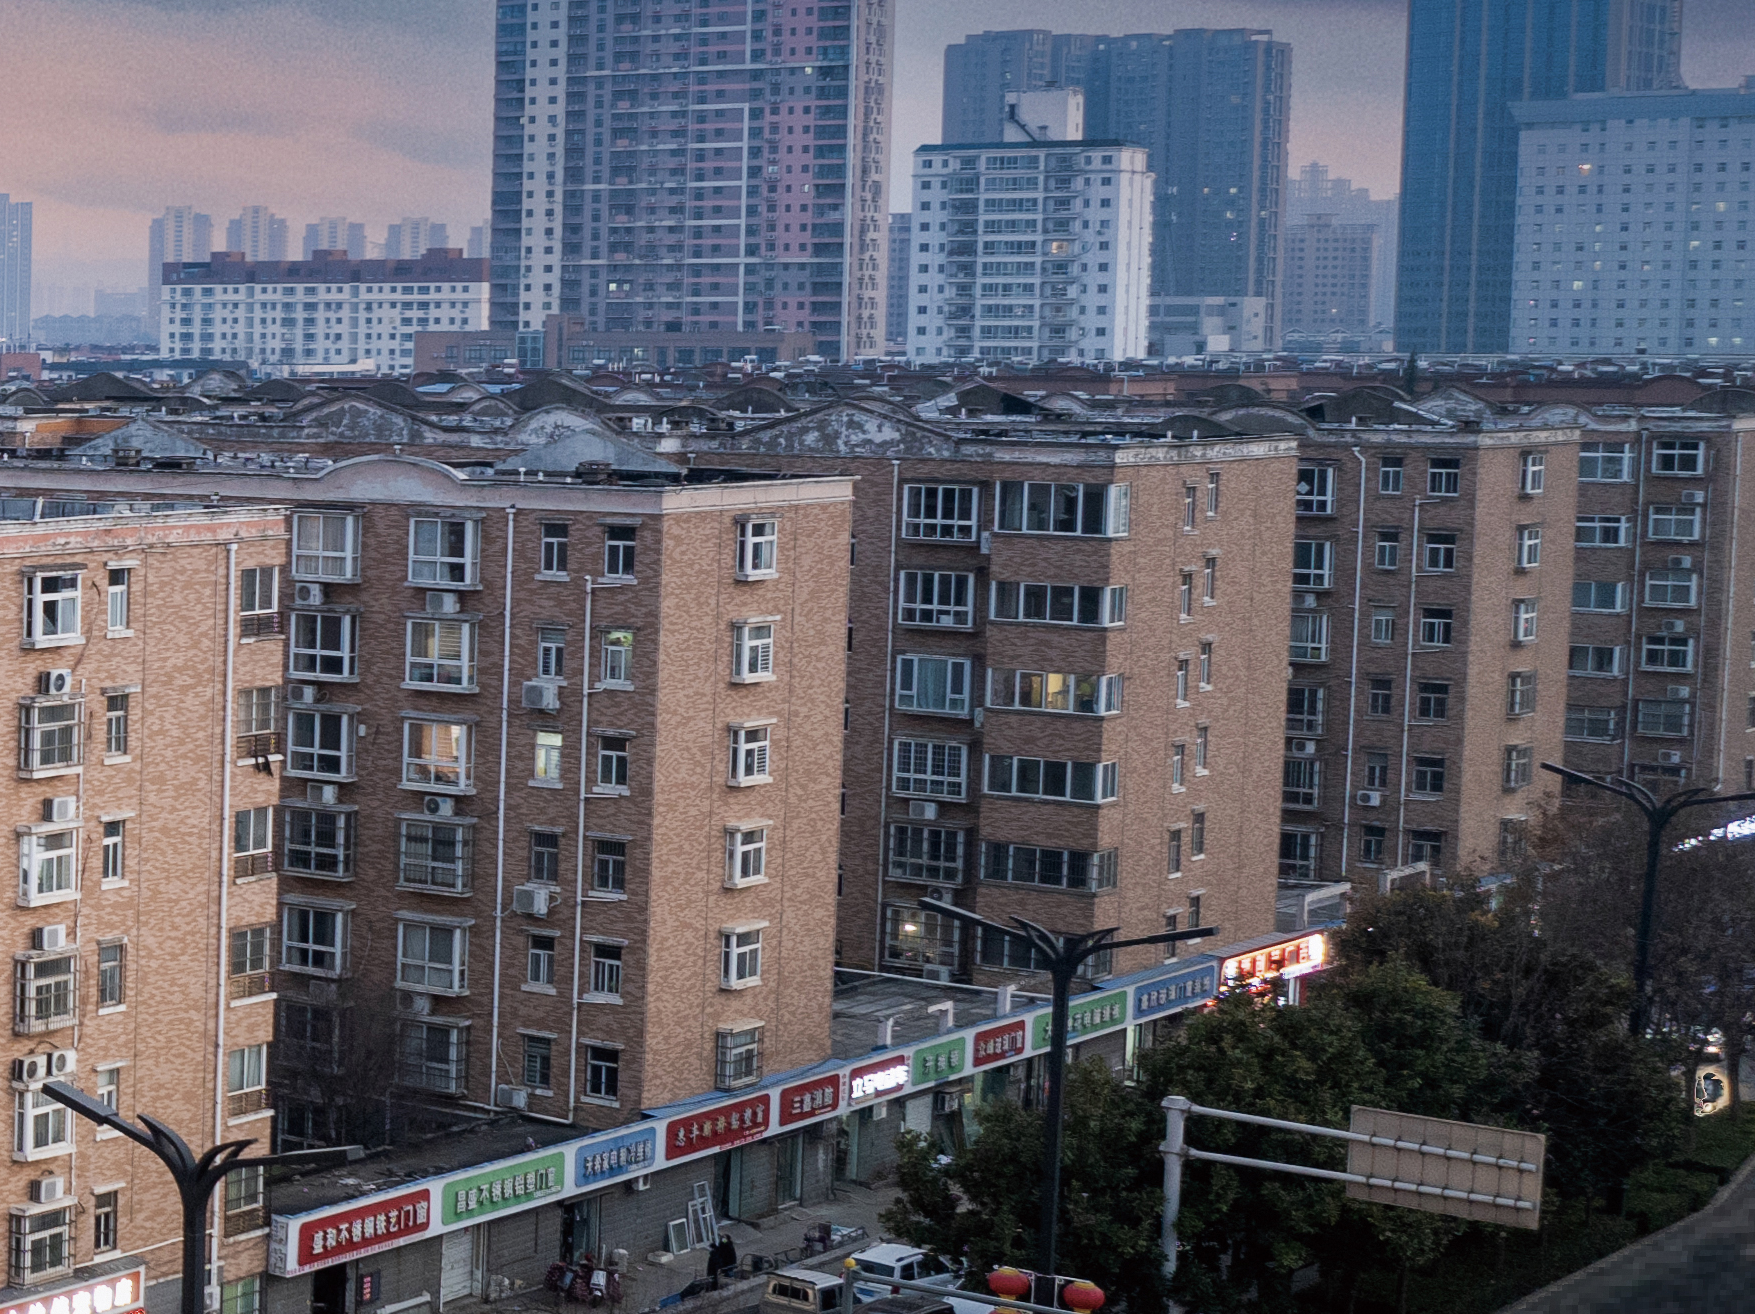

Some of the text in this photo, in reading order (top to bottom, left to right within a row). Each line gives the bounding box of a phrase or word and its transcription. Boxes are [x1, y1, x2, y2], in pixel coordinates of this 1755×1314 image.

[456, 1166, 556, 1214] 昌盛不锈钢铝塑门窗
